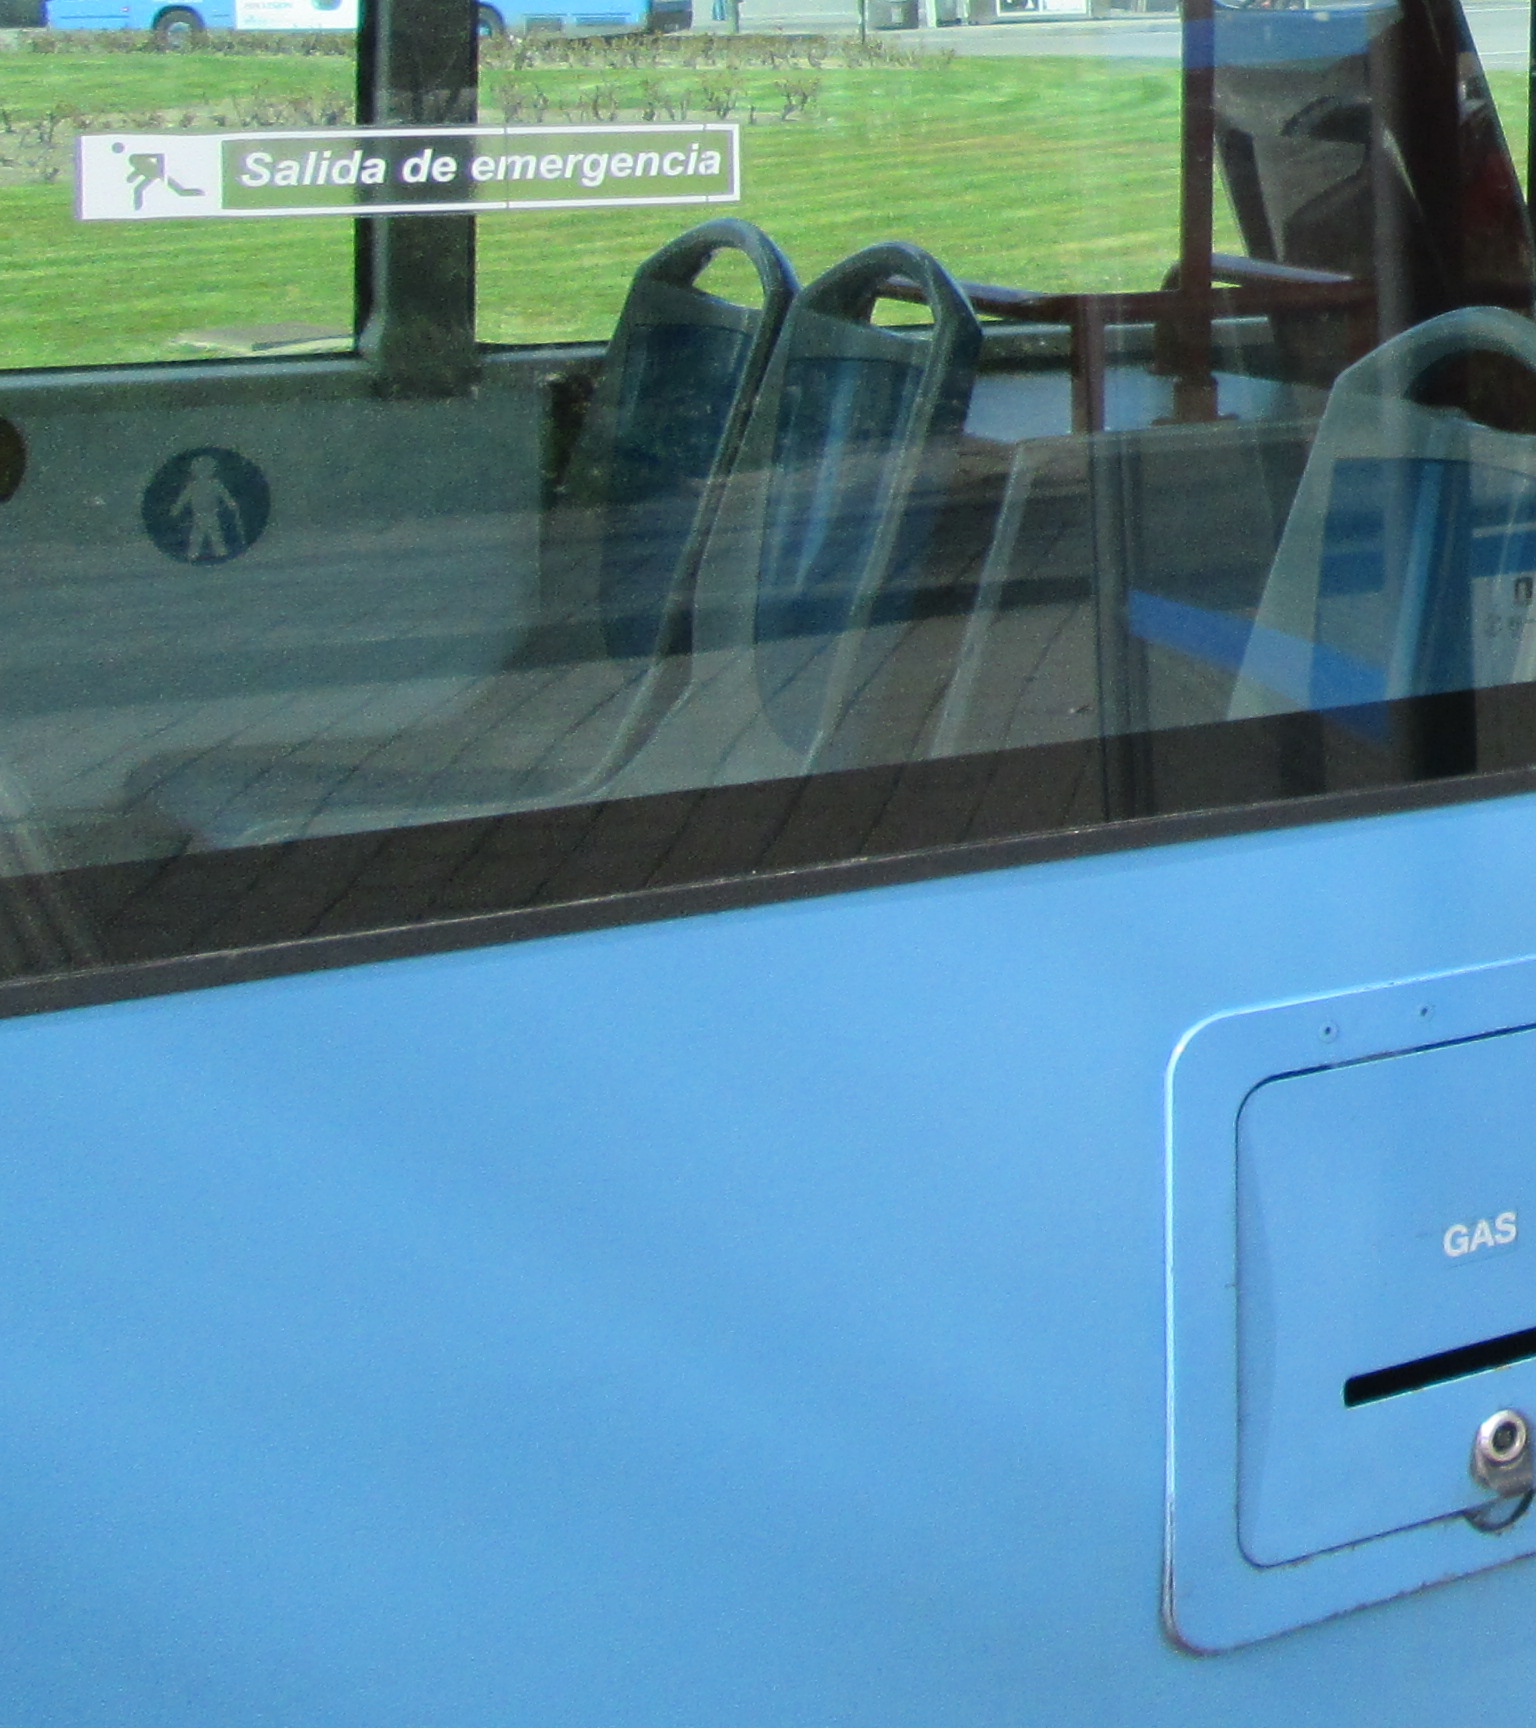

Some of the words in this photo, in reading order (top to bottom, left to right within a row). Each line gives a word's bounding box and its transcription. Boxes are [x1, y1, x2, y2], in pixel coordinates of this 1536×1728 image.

[239, 149, 386, 188] Salida
[399, 147, 457, 184] de
[470, 144, 722, 188] emergencia
[1443, 1212, 1517, 1258] GAS
